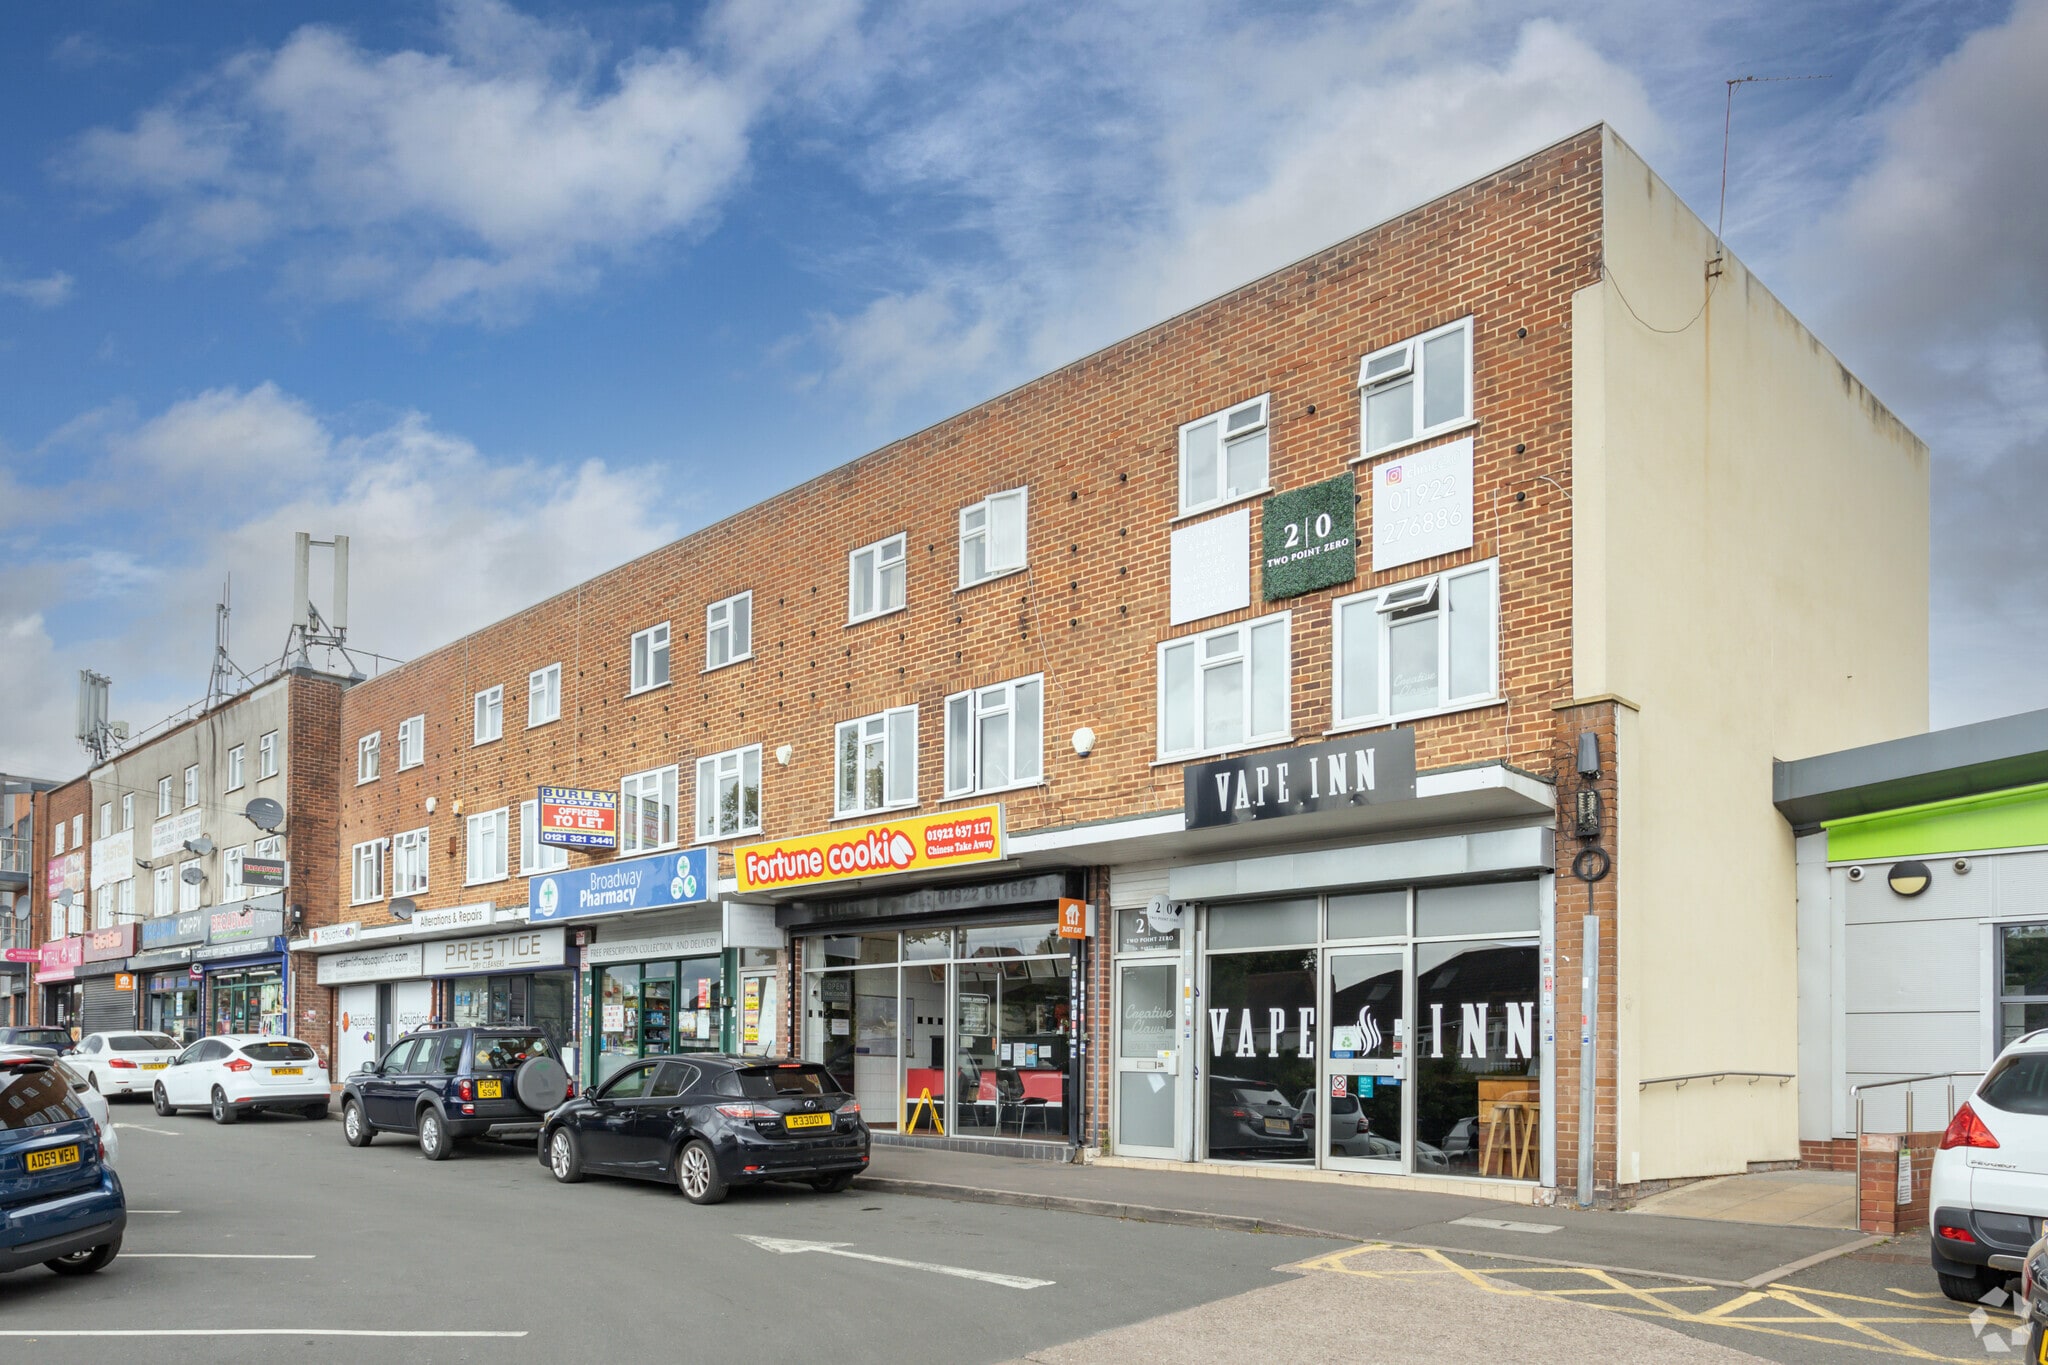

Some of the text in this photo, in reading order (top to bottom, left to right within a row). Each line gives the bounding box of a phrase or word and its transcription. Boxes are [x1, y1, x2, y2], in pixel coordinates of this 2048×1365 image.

[1388, 476, 1456, 512] 01922
[1382, 505, 1463, 545] 276886
[1267, 538, 1350, 568] TWO POINT ZERO
[1215, 748, 1376, 812] VAPE INN
[543, 789, 614, 801] BURLEY
[544, 799, 613, 807] BROWNE
[558, 808, 600, 816] OFFICES
[553, 815, 604, 828] TO LET
[544, 833, 566, 841] 0121
[590, 837, 613, 845] 3441
[927, 821, 991, 842] 01922 637 117
[928, 838, 993, 856] Chinese Take Away
[244, 864, 283, 873] BROADWAY
[747, 851, 821, 883] Fortune
[591, 869, 642, 891] Broadway
[580, 888, 637, 908] Pharmacy
[178, 915, 202, 936] CHIPPY
[211, 909, 254, 933] BROADWAY
[420, 910, 483, 928] Alterations & Repairs
[321, 929, 345, 941] Aquatics
[445, 934, 541, 963] PRESTIGE
[591, 937, 717, 957] FREE PRESCRIPTION COLLECTION AND DELIVERY
[472, 959, 505, 969] DRY CLEANERS
[399, 1011, 429, 1026] Aquatics
[1125, 1003, 1174, 1019] Creative
[350, 1013, 376, 1028] Aquatics
[1132, 1018, 1166, 1034] Claws
[1208, 1001, 1535, 1059] VAPE INN
[479, 1081, 499, 1089] FG04
[482, 1089, 497, 1097] SSK
[31, 1147, 76, 1168] AD59 WEH
[1971, 1160, 2017, 1169] PEUGEOT
